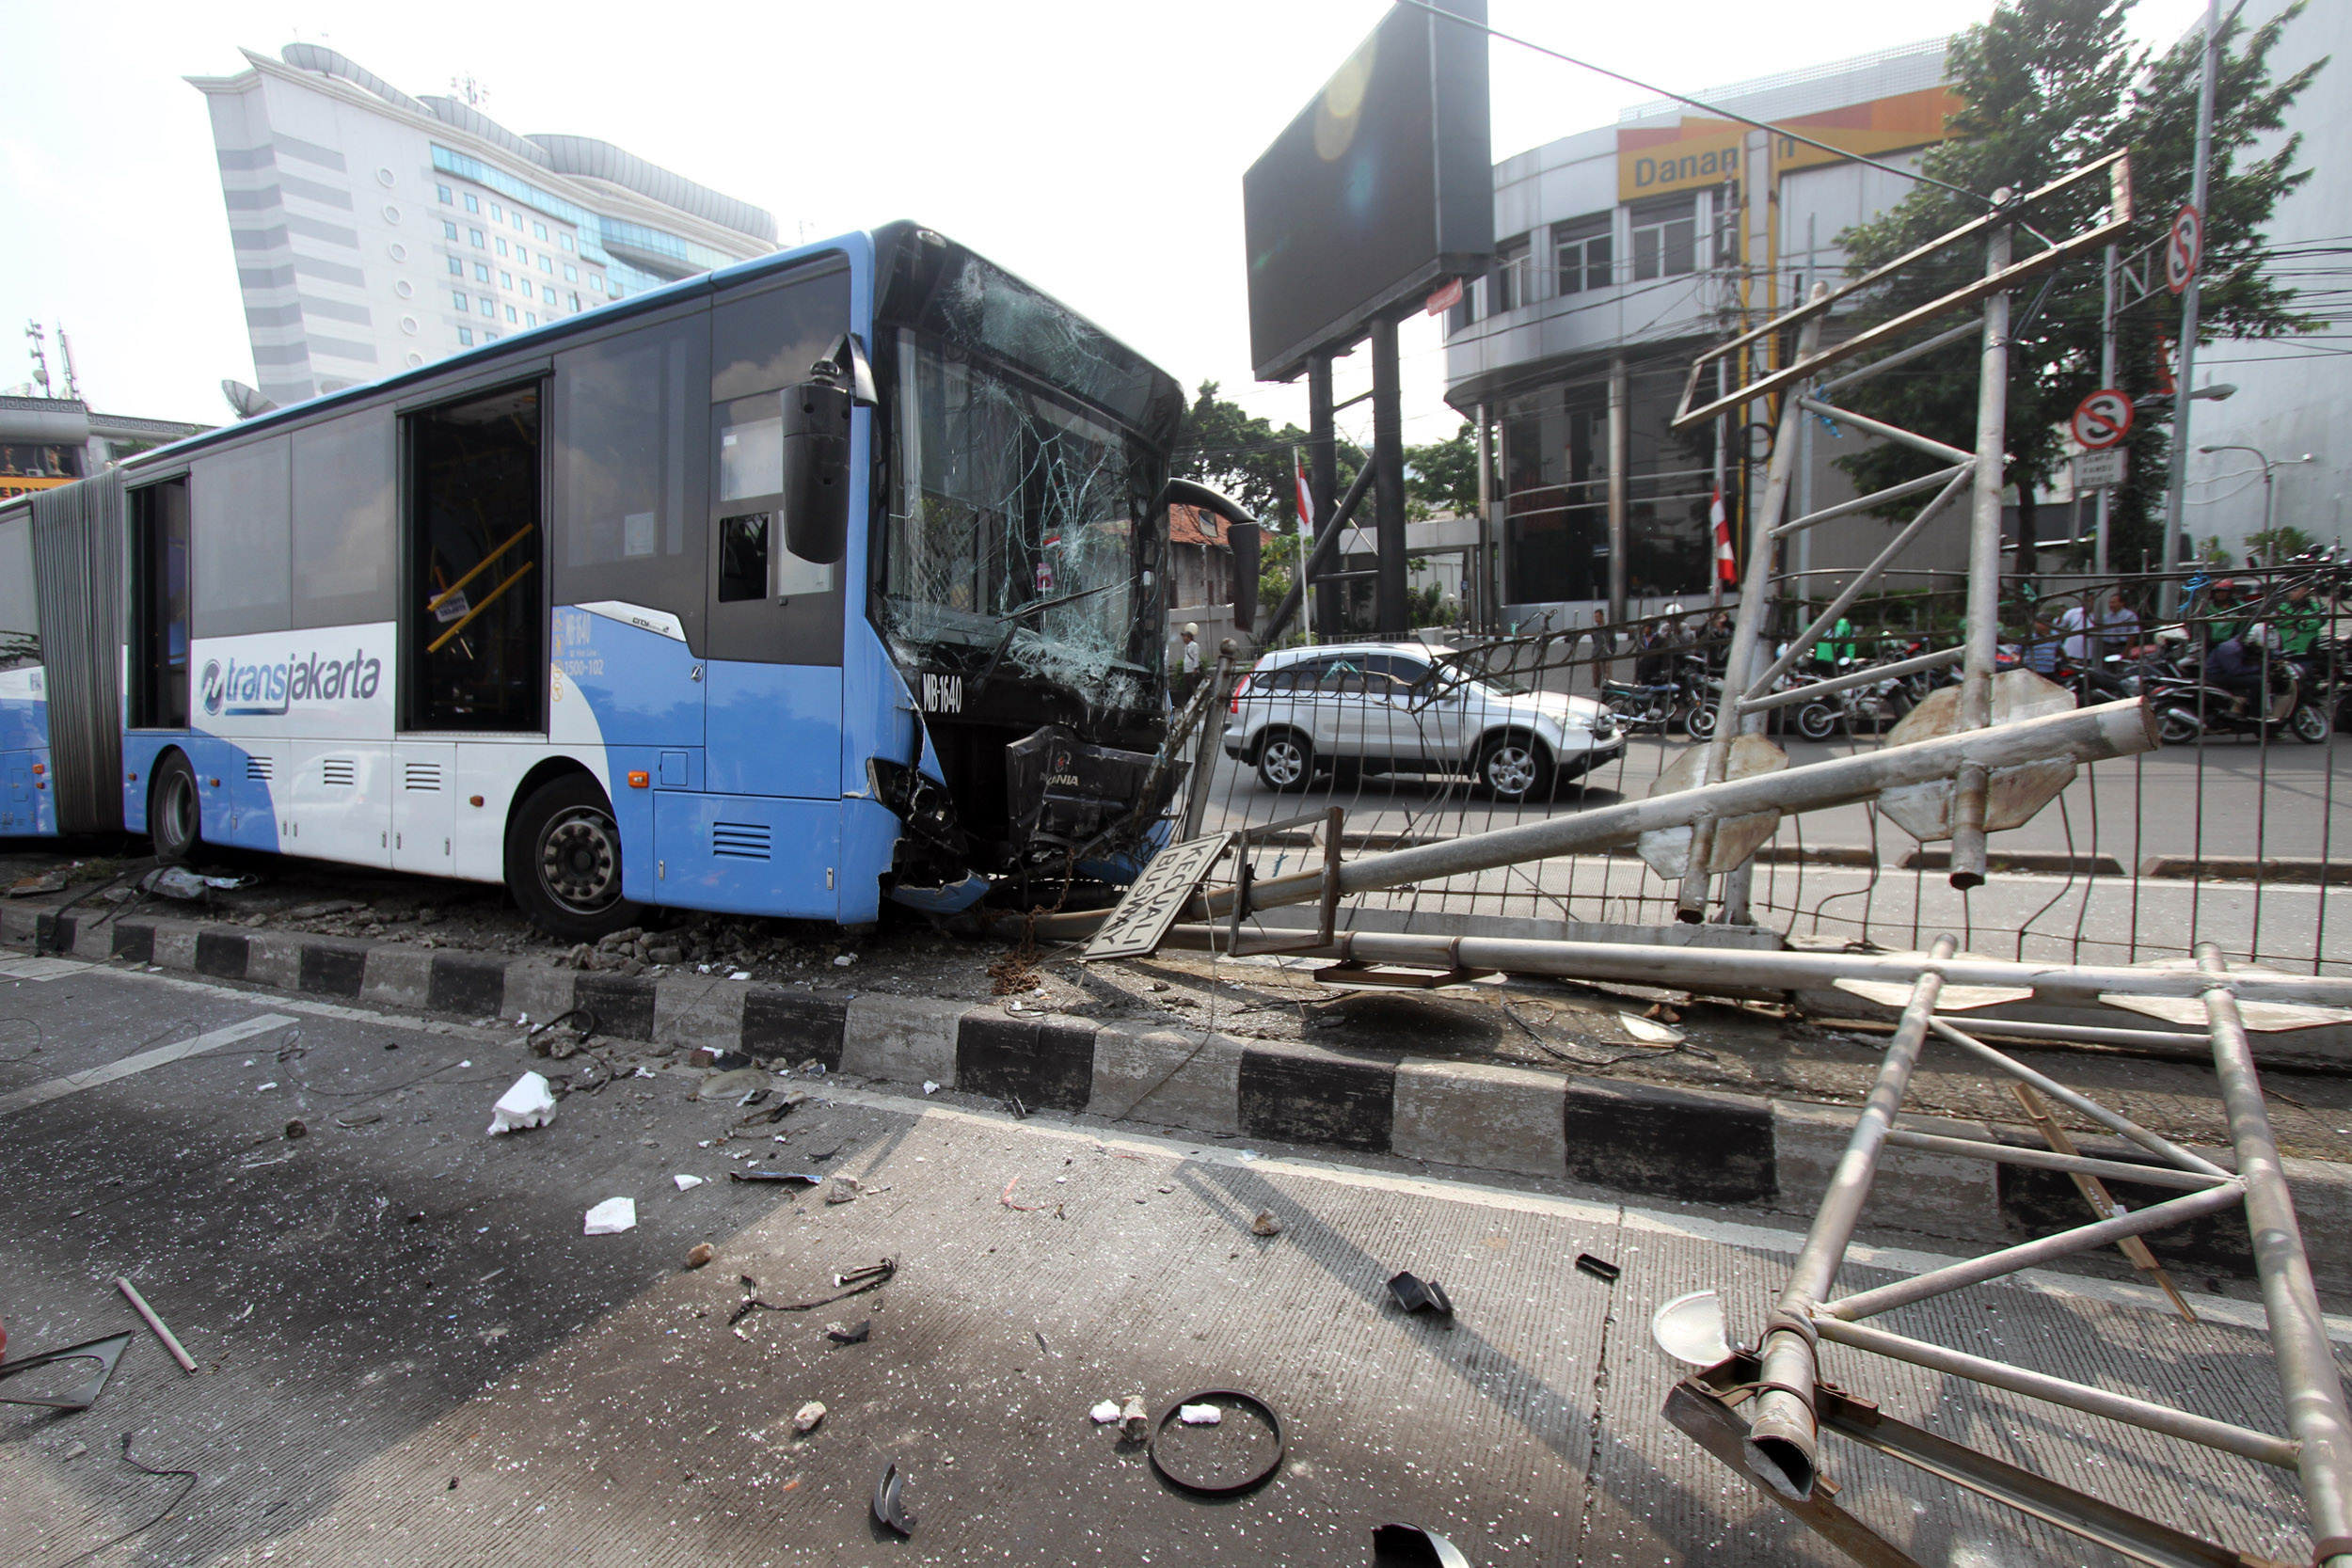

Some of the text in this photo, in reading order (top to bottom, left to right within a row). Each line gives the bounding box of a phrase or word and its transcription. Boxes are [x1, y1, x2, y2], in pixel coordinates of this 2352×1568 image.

[225, 647, 382, 716] transjakarta
[564, 659, 604, 676] 1500-102
[922, 673, 962, 714] MB-1640
[1102, 851, 1180, 946] BUSWAY
[1121, 844, 1209, 945] KECUALI
